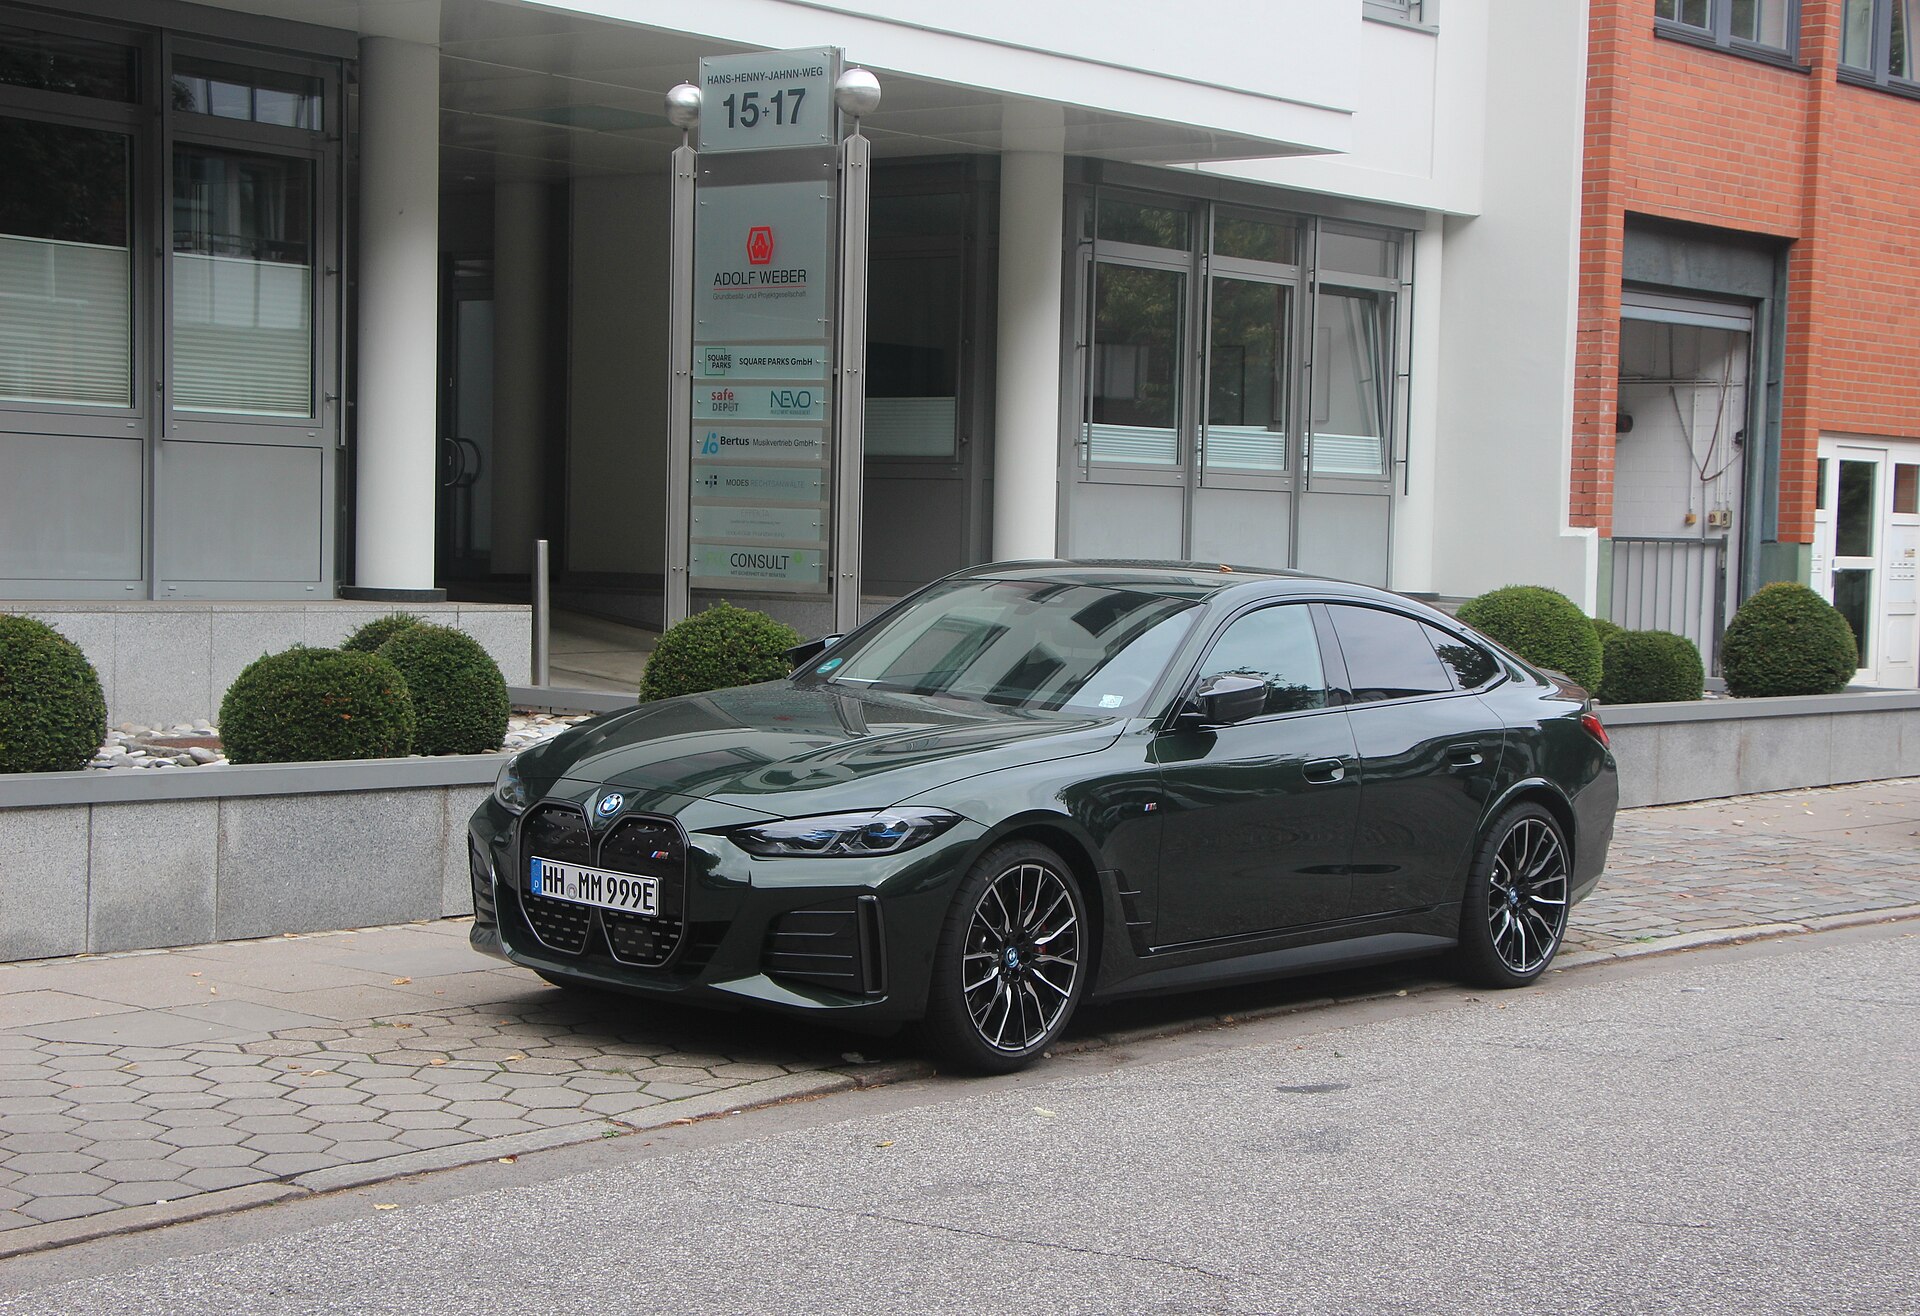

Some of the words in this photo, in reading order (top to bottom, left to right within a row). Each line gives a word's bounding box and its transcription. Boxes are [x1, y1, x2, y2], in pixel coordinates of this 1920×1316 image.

[707, 66, 823, 85] HANS-HENNY-JAHNN-WEG
[713, 271, 756, 286] ADOLF
[759, 269, 807, 284] WEBER
[747, 291, 757, 299] und
[711, 361, 732, 369] PARKS
[739, 357, 767, 366] SQUARE
[767, 357, 790, 366] PARKS
[790, 357, 813, 366] GmbH
[711, 388, 734, 401] safe
[770, 390, 811, 408] NEVO
[720, 436, 750, 446] Bertus
[752, 439, 792, 447] Musikvertrieb
[793, 439, 814, 447] GmbH
[725, 479, 750, 487] MODES
[730, 552, 790, 570] CONSULT
[542, 865, 565, 895] HH
[578, 871, 602, 902] MM
[606, 877, 655, 911] 999E
